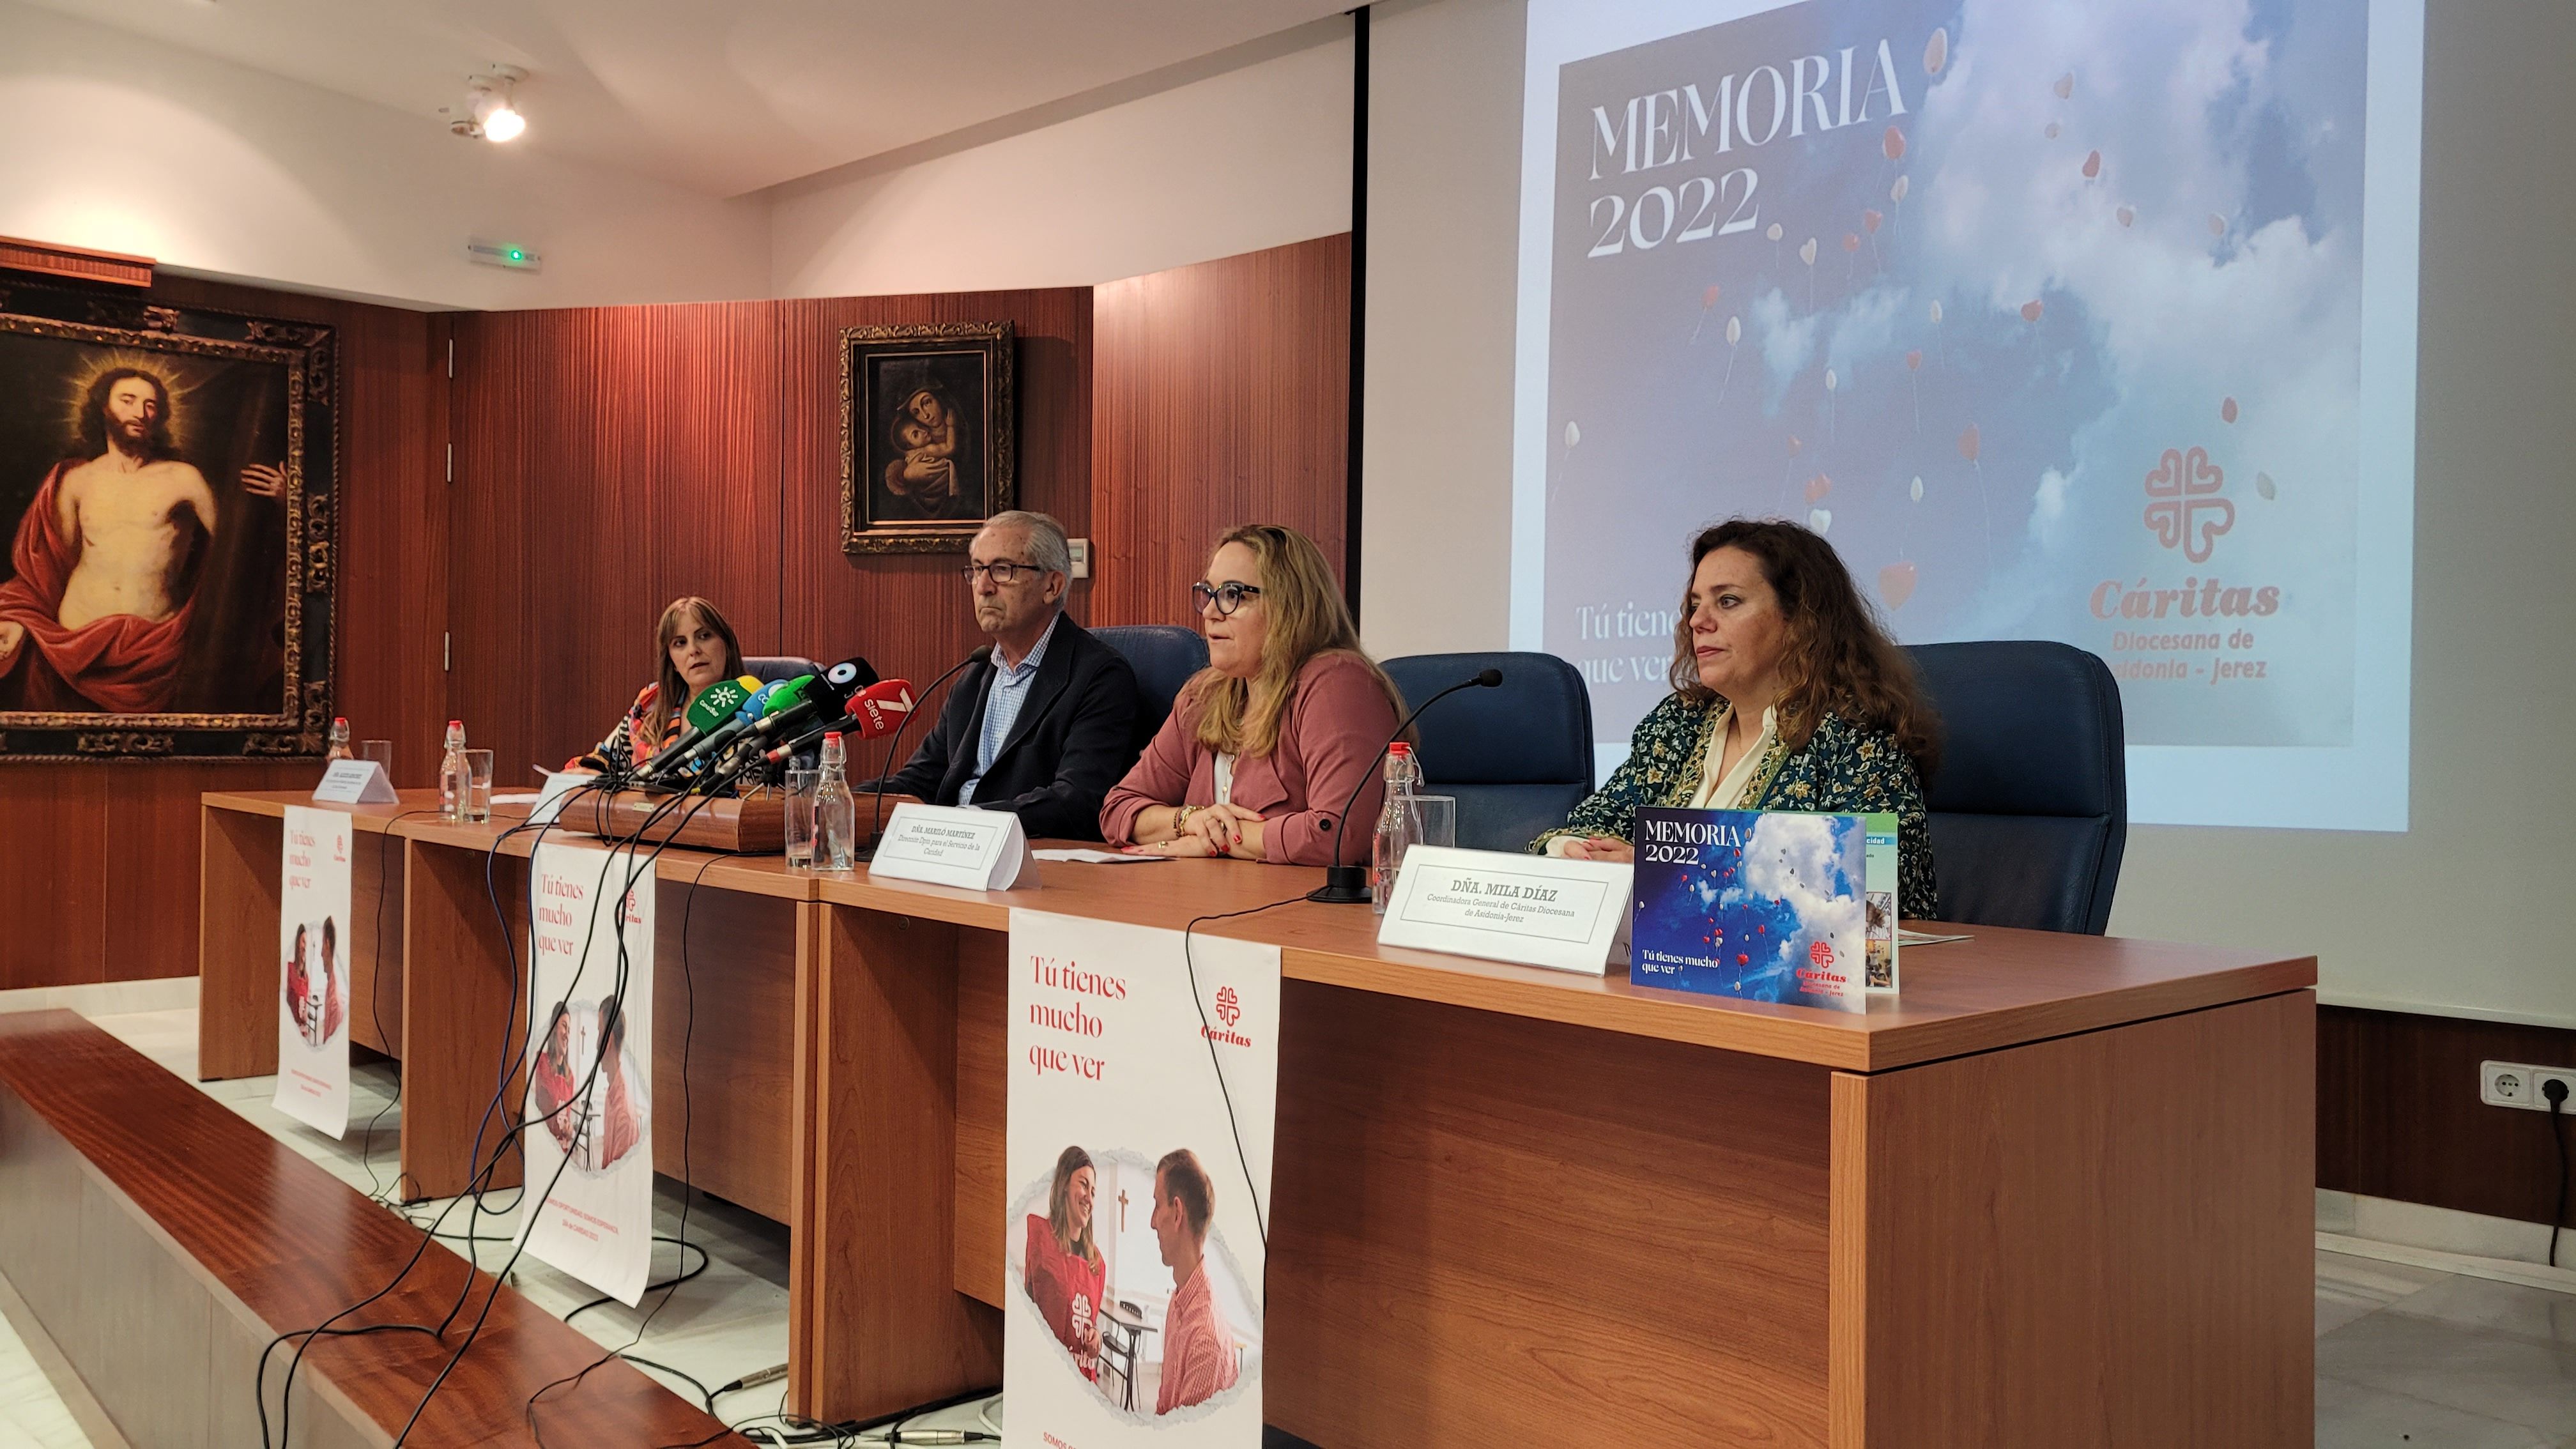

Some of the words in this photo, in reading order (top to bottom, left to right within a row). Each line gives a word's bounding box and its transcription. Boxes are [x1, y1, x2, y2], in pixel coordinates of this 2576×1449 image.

[1588, 38, 1909, 181] MEMORIA
[1587, 167, 1761, 259] 2022
[2089, 576, 2281, 621] Cáritas
[1575, 602, 1610, 640] Tú
[2112, 630, 2221, 651] Diocesana
[2227, 628, 2255, 650] de
[1576, 657, 1624, 691] que
[1629, 655, 1673, 682] ver
[2110, 659, 2188, 680] sidonia
[2193, 666, 2205, 675] -
[864, 698, 884, 730] siete
[930, 839, 942, 847] para
[947, 840, 967, 850] Servicio
[946, 829, 976, 839] MARTÍNEZ
[1644, 820, 1742, 847] MEMORIA
[923, 847, 944, 857] Caridad
[1645, 844, 1699, 865] 2022
[542, 873, 554, 894] Tú
[555, 875, 583, 900] tienes
[1450, 877, 1482, 894] DÑA.
[1484, 882, 1520, 898] MILA
[1521, 885, 1558, 902] DÍAZ
[539, 903, 572, 927] mucho
[1427, 893, 1471, 906] Coordinadora
[1472, 898, 1499, 908] General
[1499, 901, 1510, 910] de
[1510, 902, 1537, 913] Cáritas
[1537, 905, 1575, 917] Diocesana
[1473, 909, 1524, 923] Asidonia-Jerez
[539, 935, 556, 956] que
[558, 940, 574, 956] ver
[1641, 962, 1659, 974] que
[1660, 965, 1676, 975] ver
[1642, 949, 1655, 961] Tú
[1656, 950, 1684, 965] tienes
[1685, 955, 1719, 969] mucho
[1029, 955, 1057, 988] Tú
[1062, 960, 1126, 1001] tienes
[1796, 967, 1847, 983] Cáritas
[1029, 1001, 1103, 1039] mucho
[1200, 1024, 1252, 1048] Cáritas
[1029, 1043, 1068, 1077] que
[1071, 1054, 1105, 1081] ver
[1043, 1431, 1067, 1449] SOMOS
